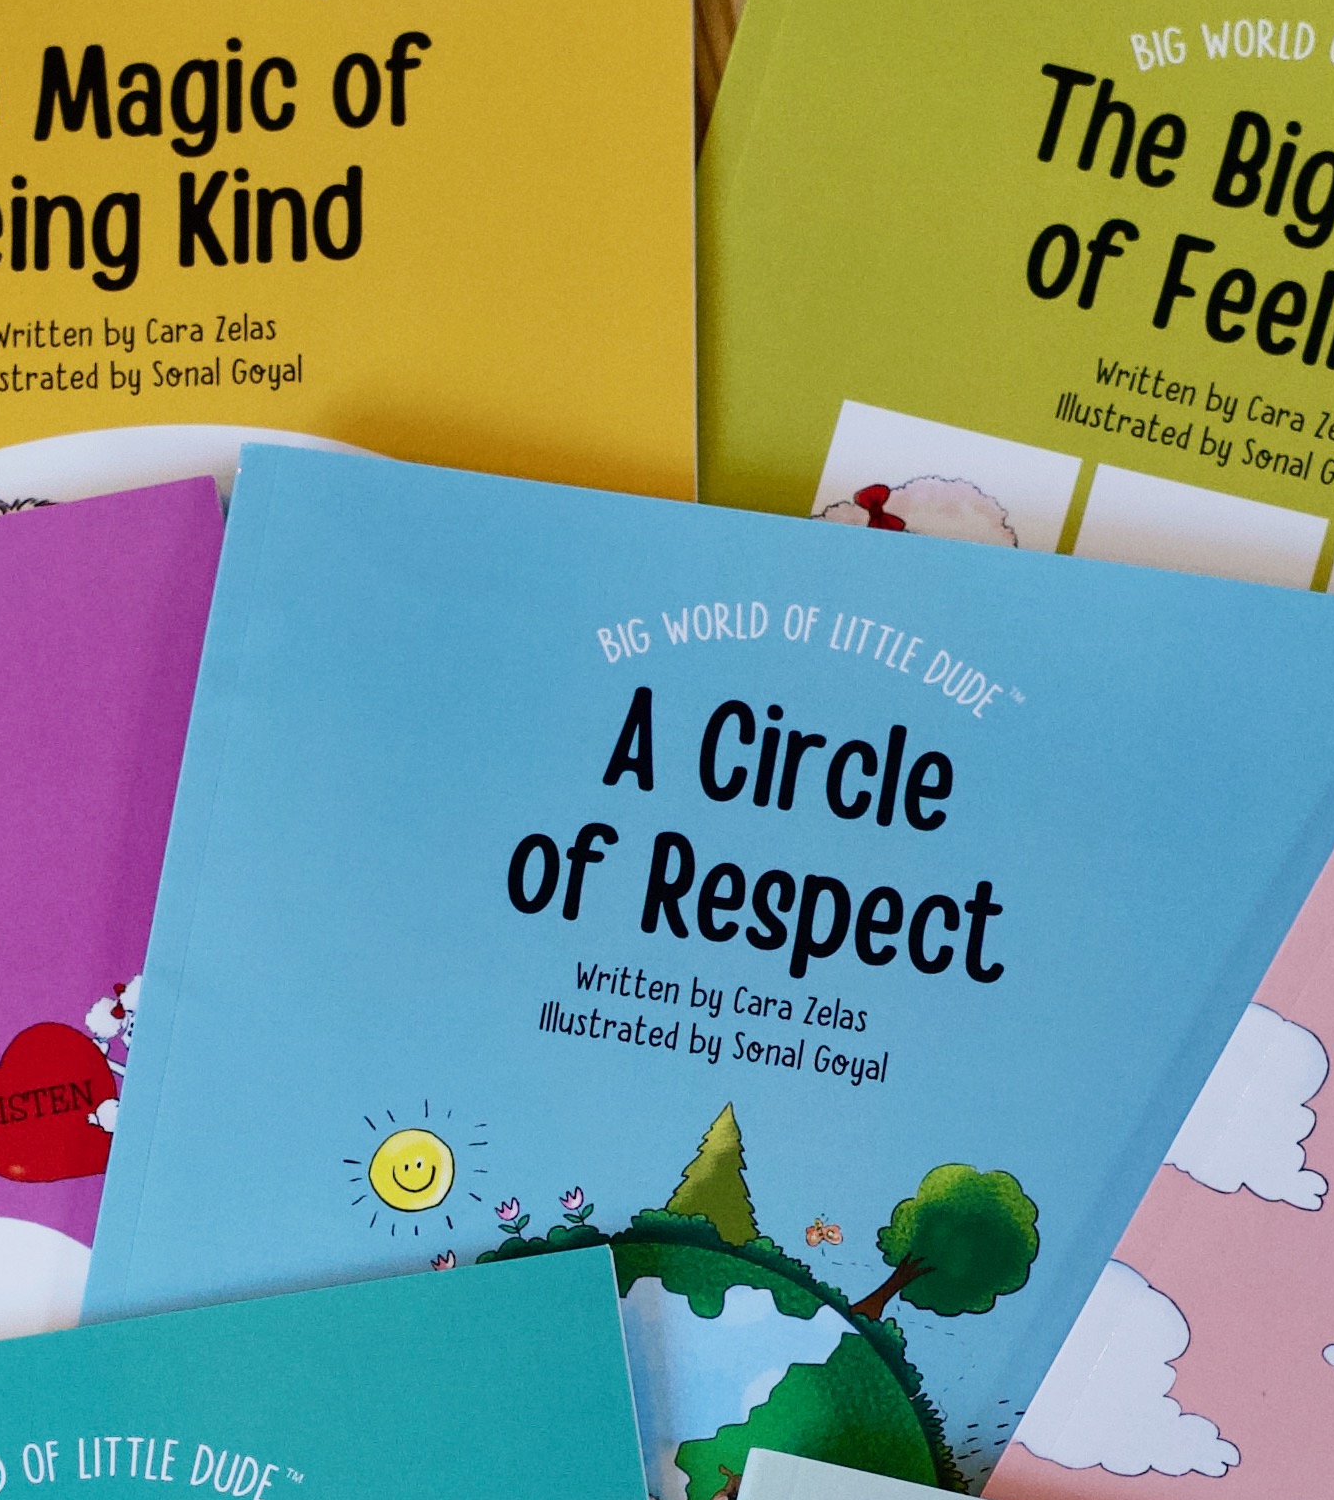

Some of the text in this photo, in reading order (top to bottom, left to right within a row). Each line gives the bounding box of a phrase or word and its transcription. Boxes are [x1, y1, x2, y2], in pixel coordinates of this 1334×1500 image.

[1131, 27, 1186, 71] BIG
[1201, 19, 1315, 60] WORLD
[34, 37, 297, 157] Magic
[333, 31, 431, 128] of
[1038, 63, 1186, 187] The
[179, 165, 362, 267] Kind
[1027, 219, 1139, 310] of
[104, 318, 135, 353] by
[147, 318, 203, 344] Cara
[216, 313, 276, 342] Zelas
[110, 361, 141, 396] by
[153, 357, 220, 387] Sonal
[232, 354, 302, 391] Goyal
[1056, 393, 1192, 449] Illustrated
[1200, 426, 1232, 467] by
[1242, 438, 1313, 480] Sonal
[1097, 358, 1196, 406] Written
[1206, 382, 1238, 423] by
[1247, 396, 1305, 432] Cara
[597, 618, 650, 663] BIG
[662, 602, 768, 644] WORLD
[784, 604, 820, 642] OF
[830, 613, 923, 673] LITTLE
[603, 687, 953, 831] A Circle
[508, 823, 1004, 983] of Respect
[578, 962, 867, 1032] Written by Cara Zelas
[539, 1001, 888, 1086] Illustrated by Sonal Goyal
[23, 1441, 58, 1483] OF
[79, 1437, 178, 1481] LITTLE
